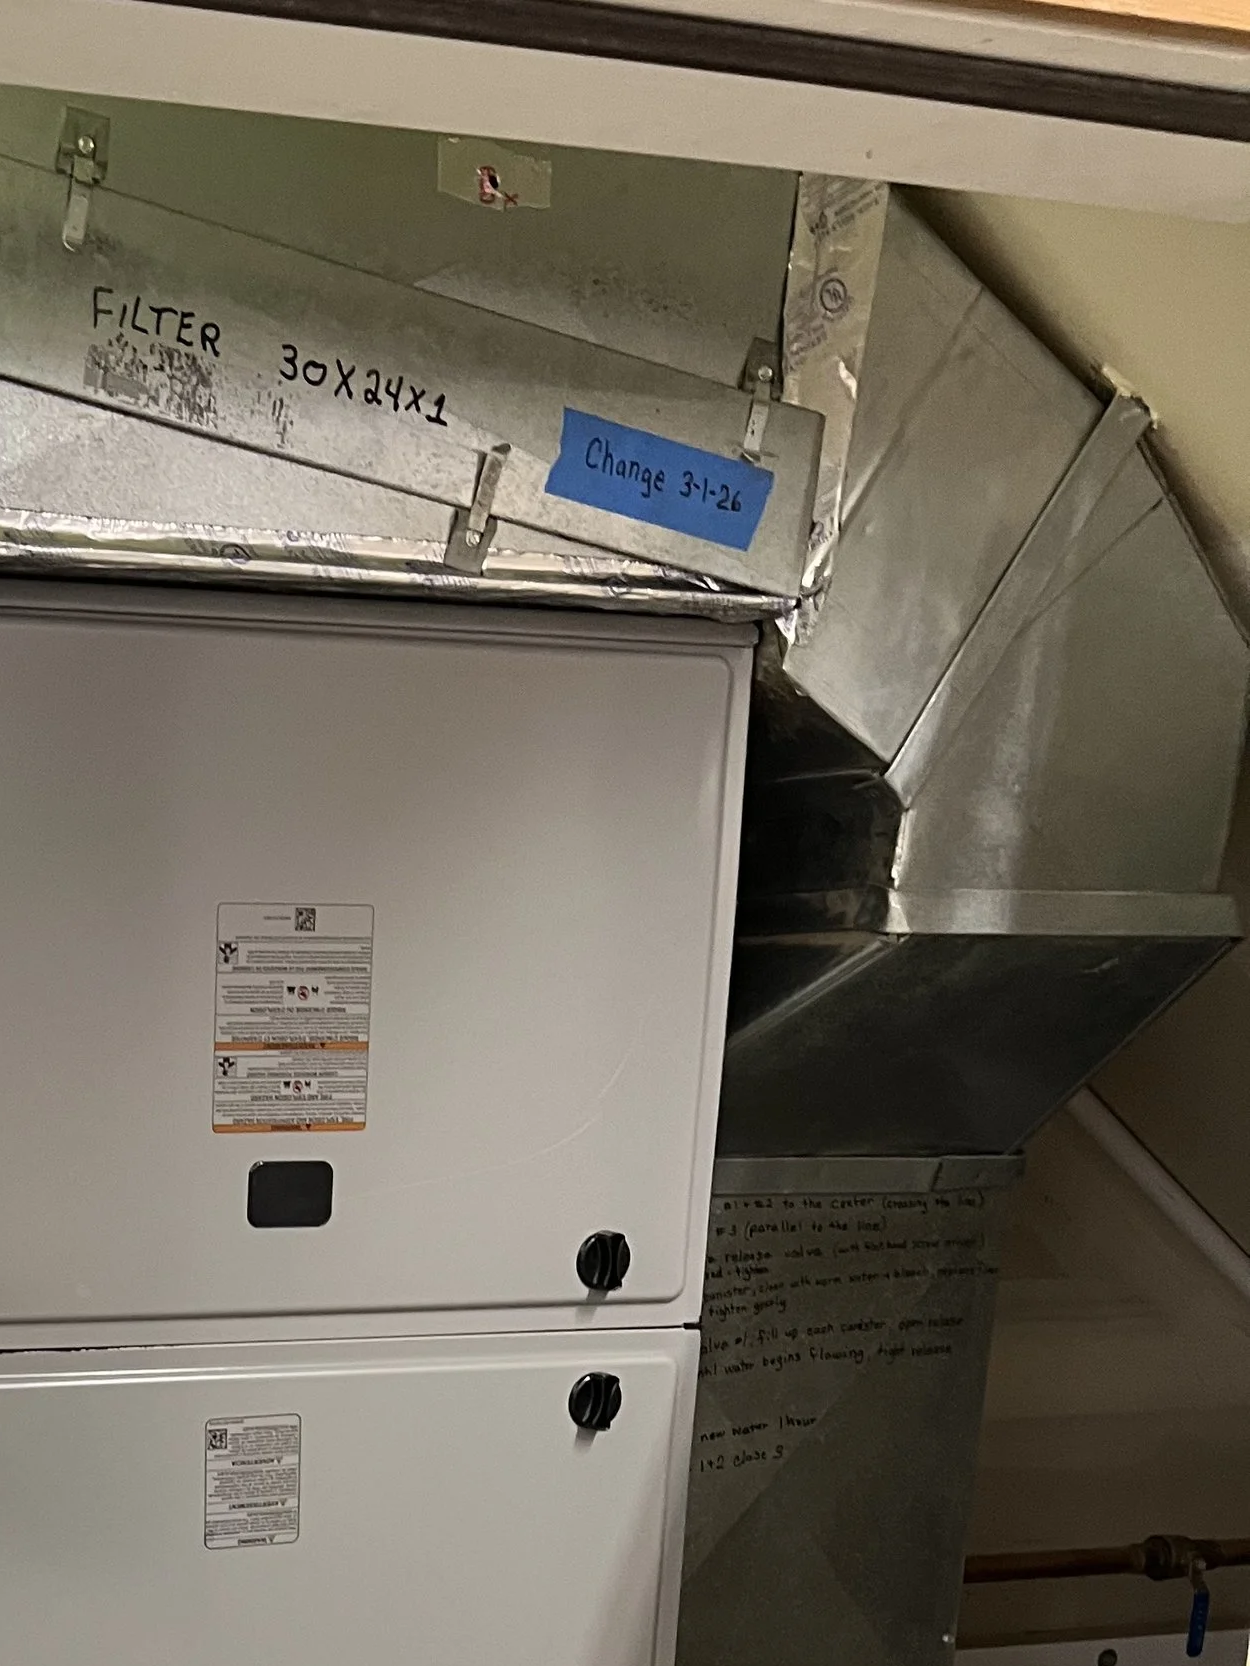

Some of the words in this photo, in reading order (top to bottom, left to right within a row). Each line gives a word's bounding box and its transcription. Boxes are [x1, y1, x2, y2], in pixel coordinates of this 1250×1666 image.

[585, 437, 666, 499] Change
[679, 470, 743, 514] 3-1-26
[762, 1351, 803, 1373] begins
